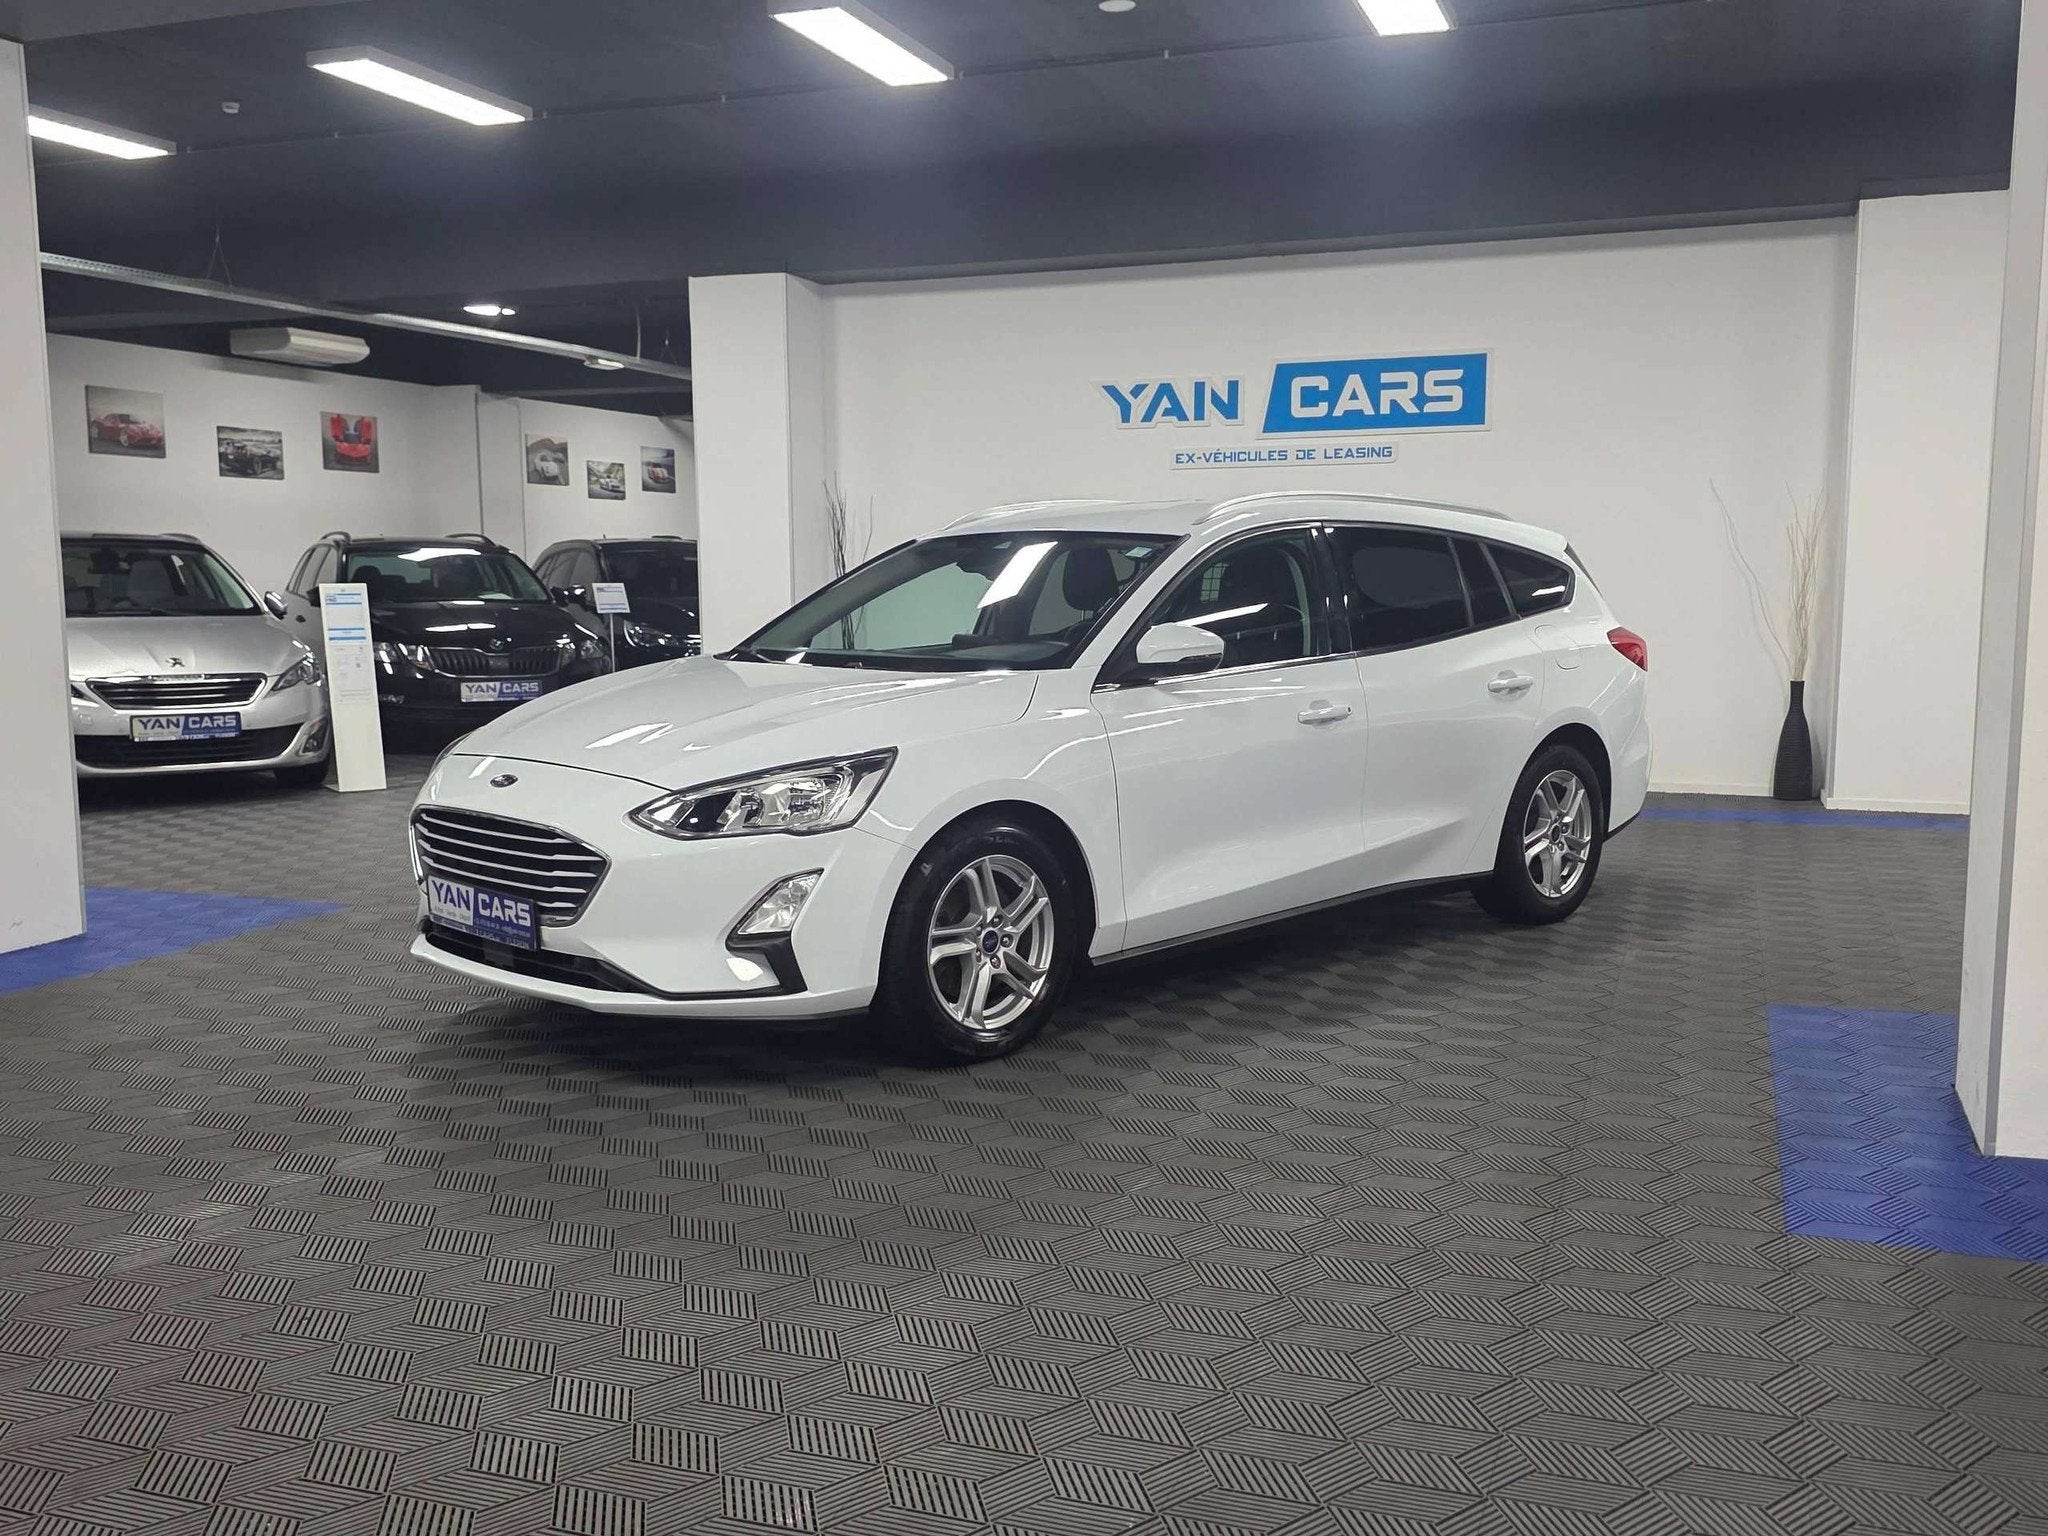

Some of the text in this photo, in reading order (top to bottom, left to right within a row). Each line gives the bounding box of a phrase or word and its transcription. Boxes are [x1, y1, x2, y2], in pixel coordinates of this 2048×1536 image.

[1101, 369, 1464, 424] YAN CARS
[1175, 446, 1393, 465] EX-VÉHICULES DE LEASING
[464, 682, 539, 694] YAN CARS
[137, 715, 237, 731] YAN CARS
[431, 880, 471, 912] YAN
[477, 892, 532, 927] CARS
